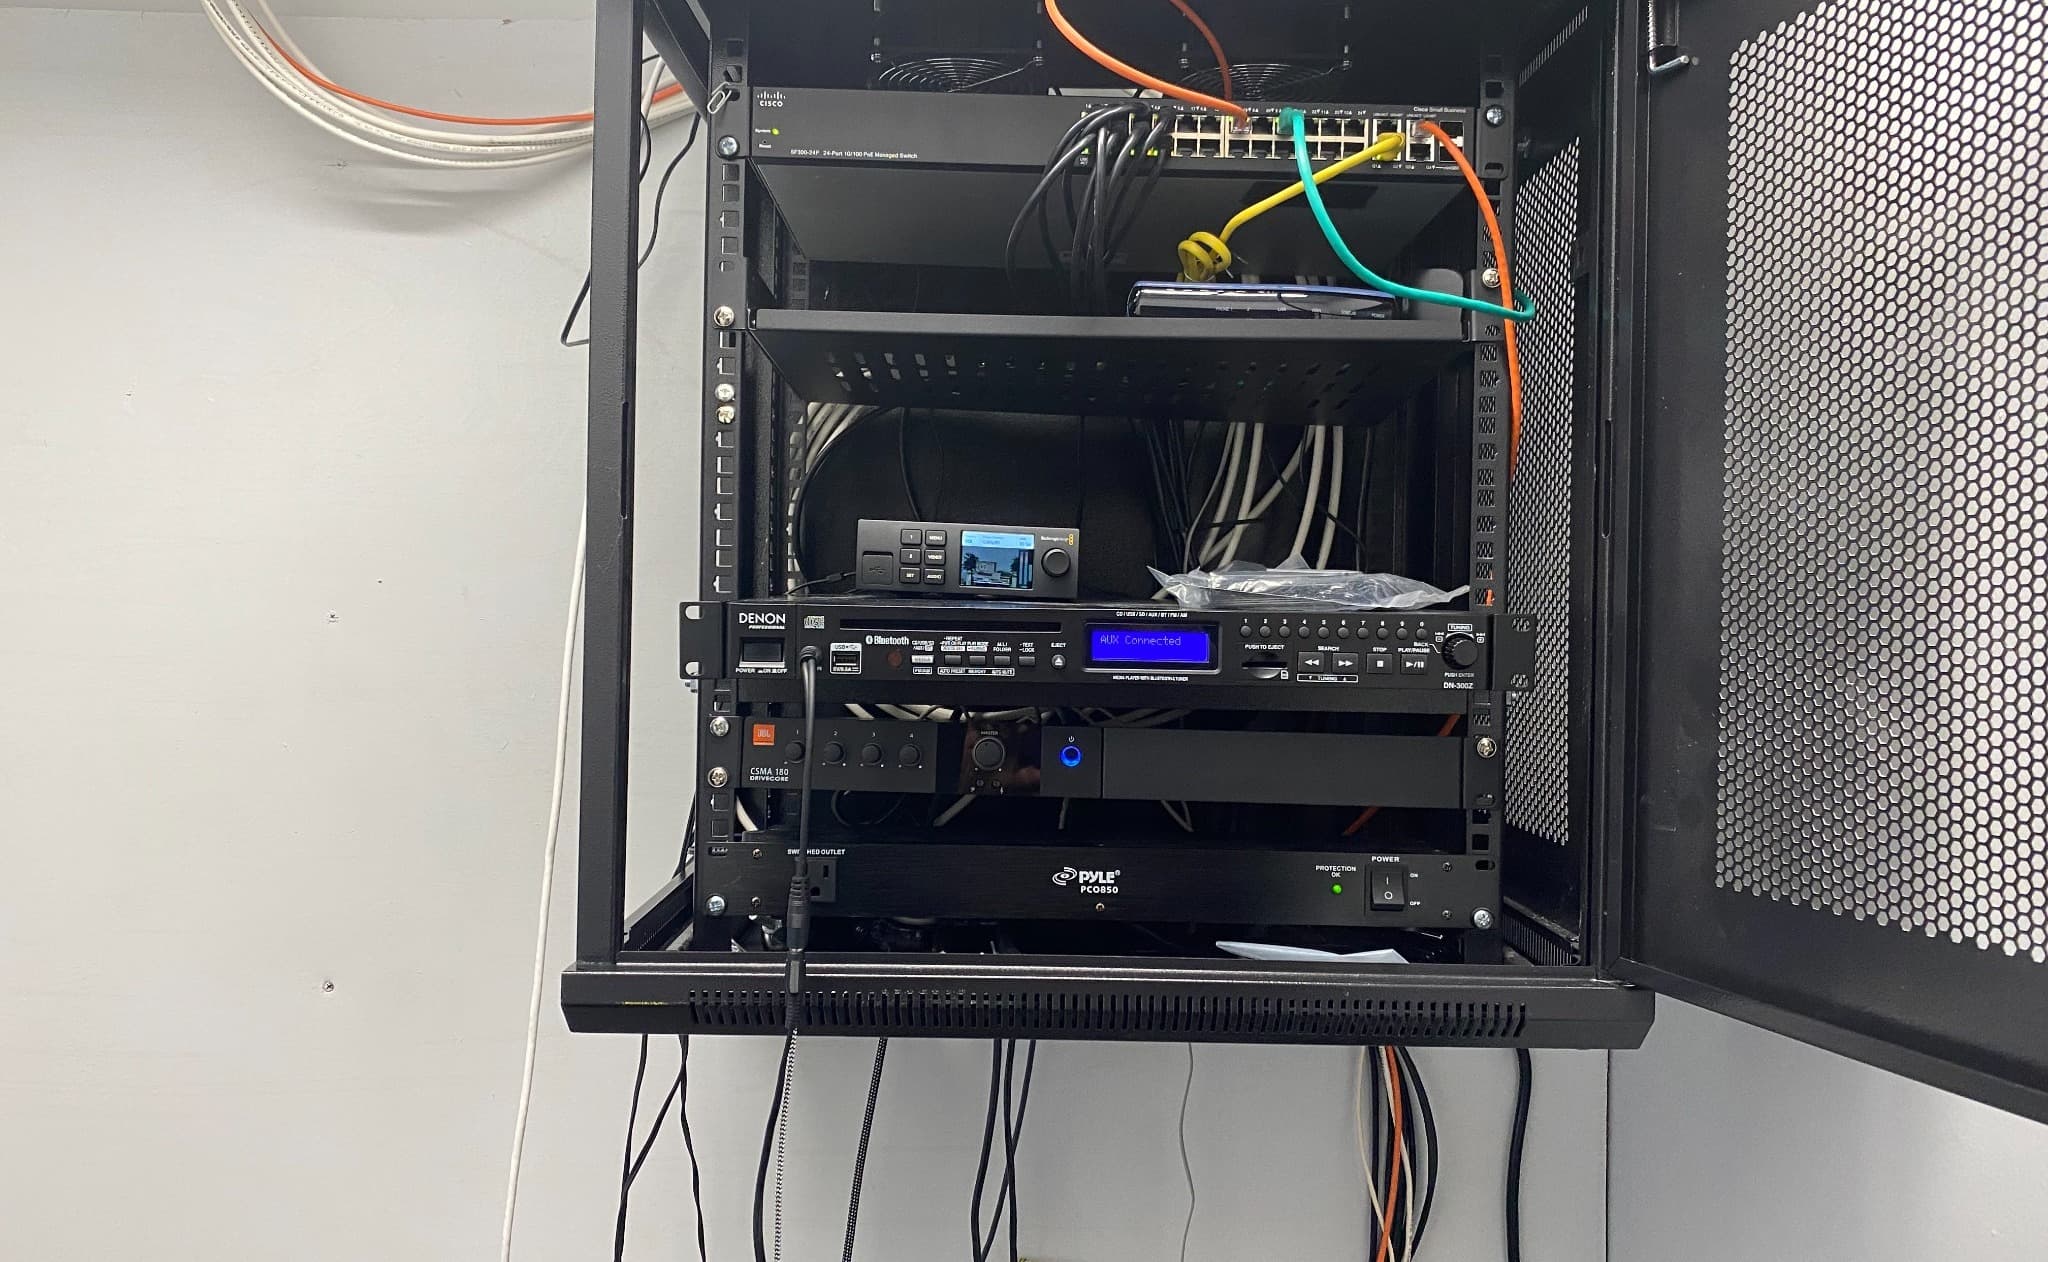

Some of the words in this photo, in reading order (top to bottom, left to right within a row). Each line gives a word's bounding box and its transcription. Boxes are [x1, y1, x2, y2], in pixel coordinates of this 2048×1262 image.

[738, 612, 786, 624] DENON
[874, 636, 910, 645] Bluetooth
[1100, 635, 1120, 645] AUX
[1124, 635, 1182, 646] Connected
[757, 729, 771, 738] JBL
[750, 768, 772, 776] CSMA
[775, 768, 789, 776] 180
[1080, 886, 1119, 894] PCO850
